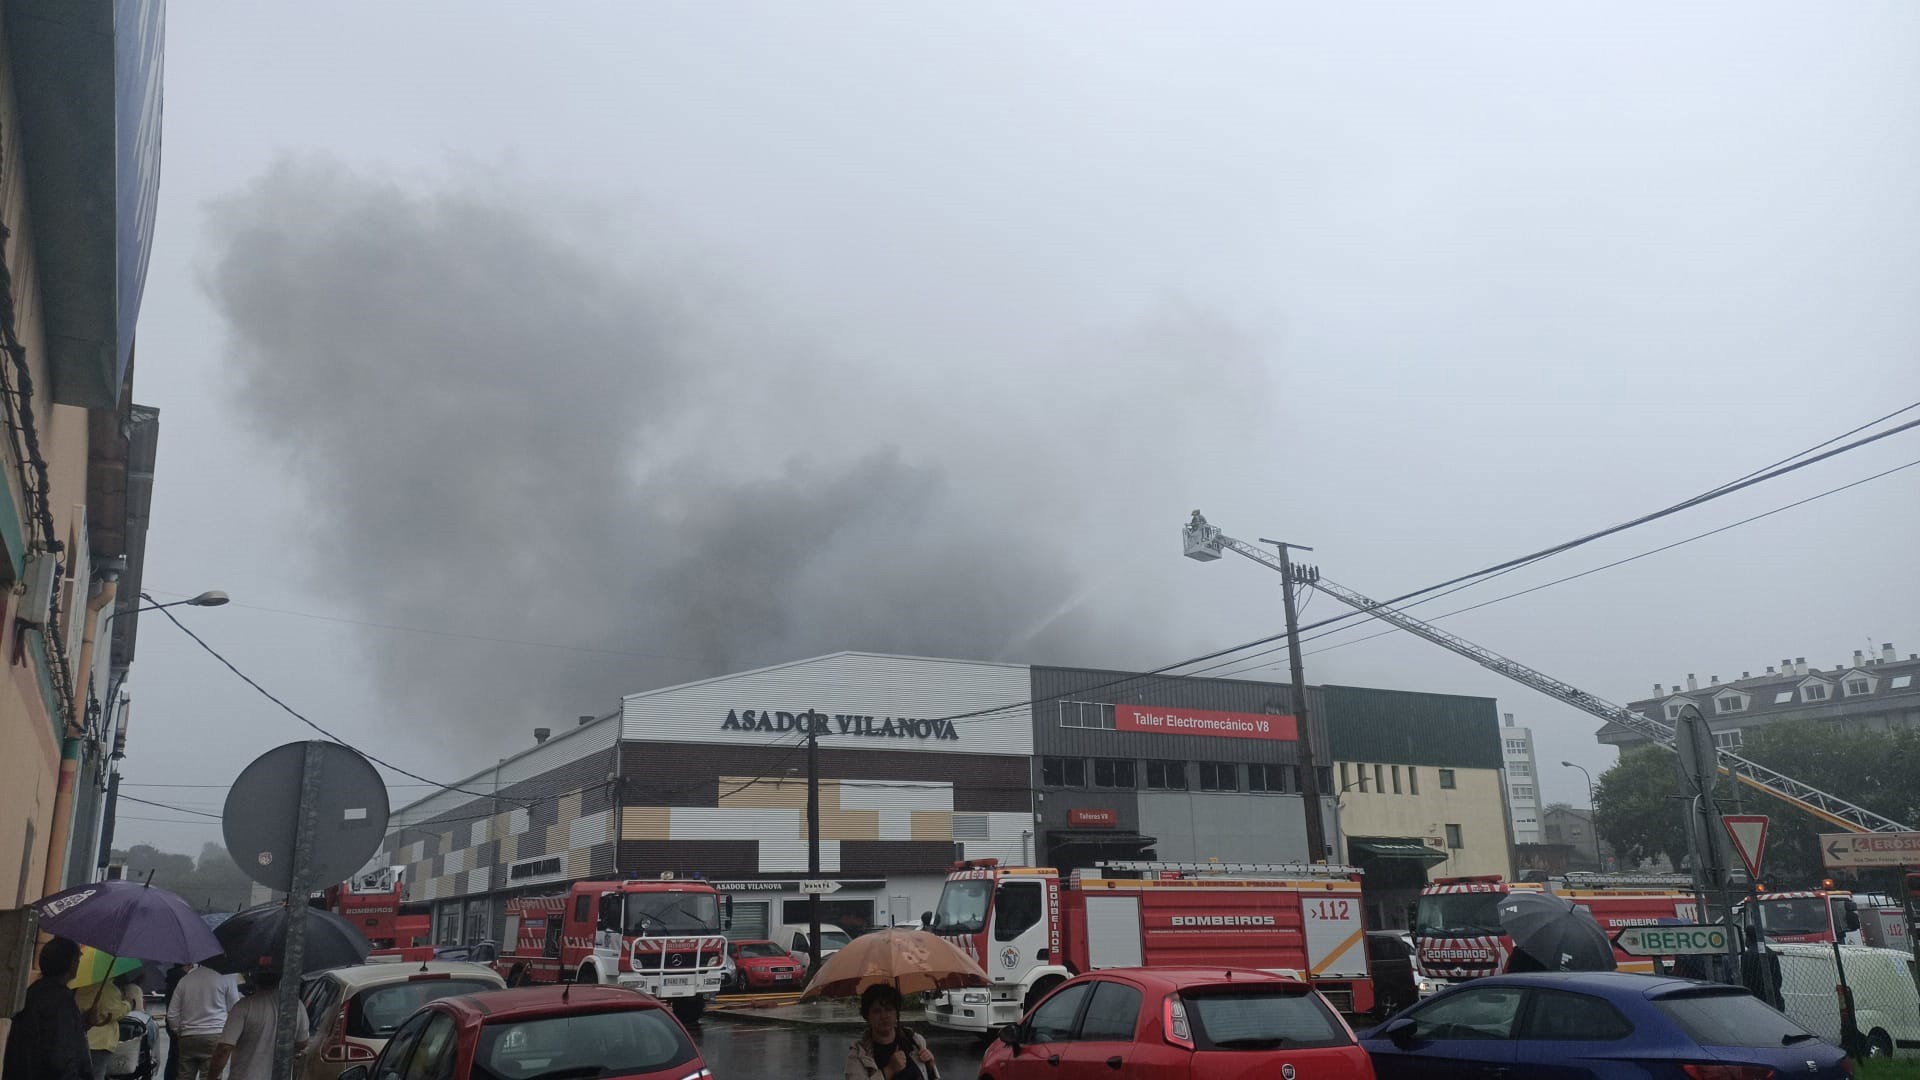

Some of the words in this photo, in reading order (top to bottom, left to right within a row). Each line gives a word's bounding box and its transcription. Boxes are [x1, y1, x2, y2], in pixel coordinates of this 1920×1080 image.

[721, 709, 832, 735] ASADOR
[835, 714, 959, 740] VILANOVA
[1133, 712, 1163, 726] Taller
[1166, 715, 1254, 732] Electromecánico
[1256, 720, 1270, 733] V8
[716, 882, 746, 890] ASADOR
[747, 882, 782, 890] VILANOVA
[1050, 885, 1060, 954] BOMBEIROS
[1319, 900, 1350, 920] 112
[1171, 916, 1275, 926] BOMBEIROS
[1609, 918, 1658, 927] BOMBEIRO
[1640, 931, 1726, 950] IBERCO
